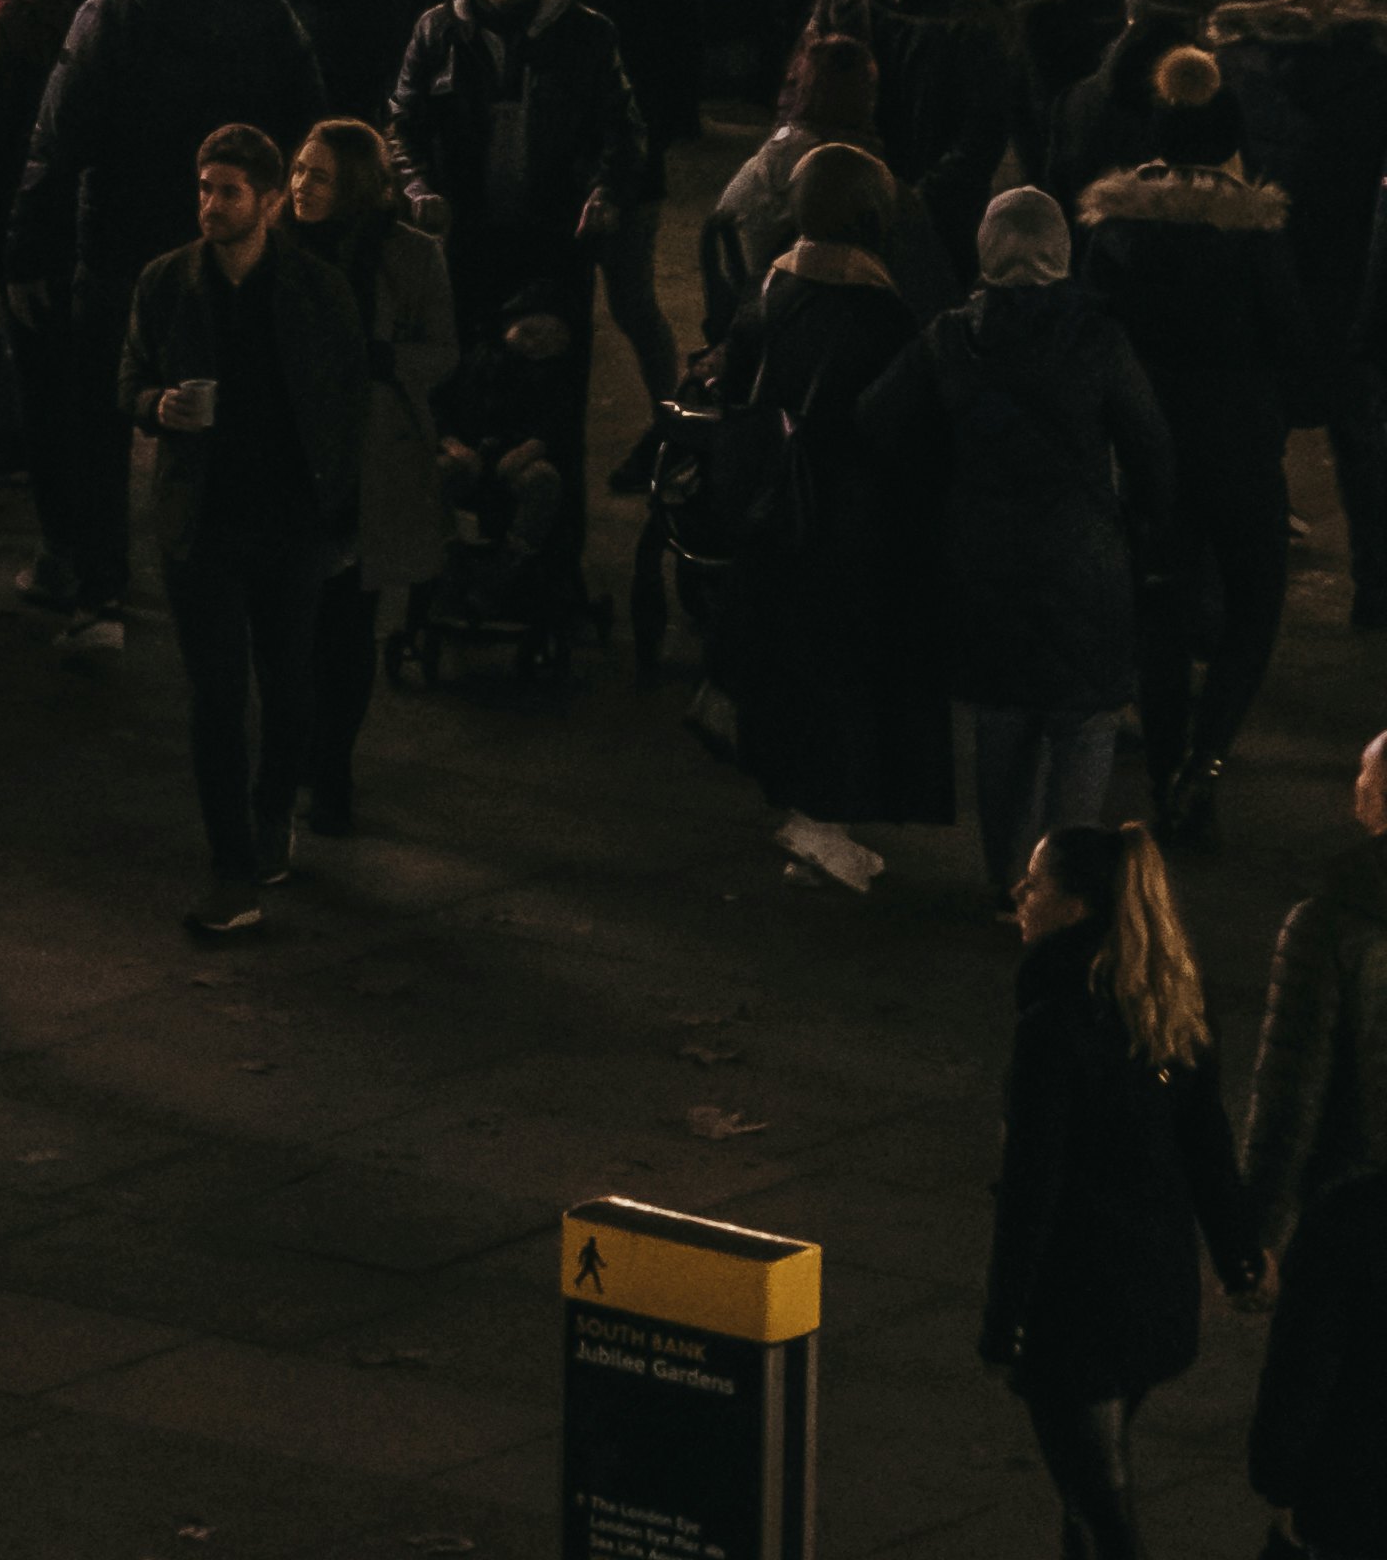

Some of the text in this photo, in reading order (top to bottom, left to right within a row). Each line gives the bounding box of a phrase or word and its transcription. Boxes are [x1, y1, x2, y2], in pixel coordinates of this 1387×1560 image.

[576, 1314, 707, 1363] SOUTH BANK
[576, 1339, 736, 1396] Jubilee Gardens
